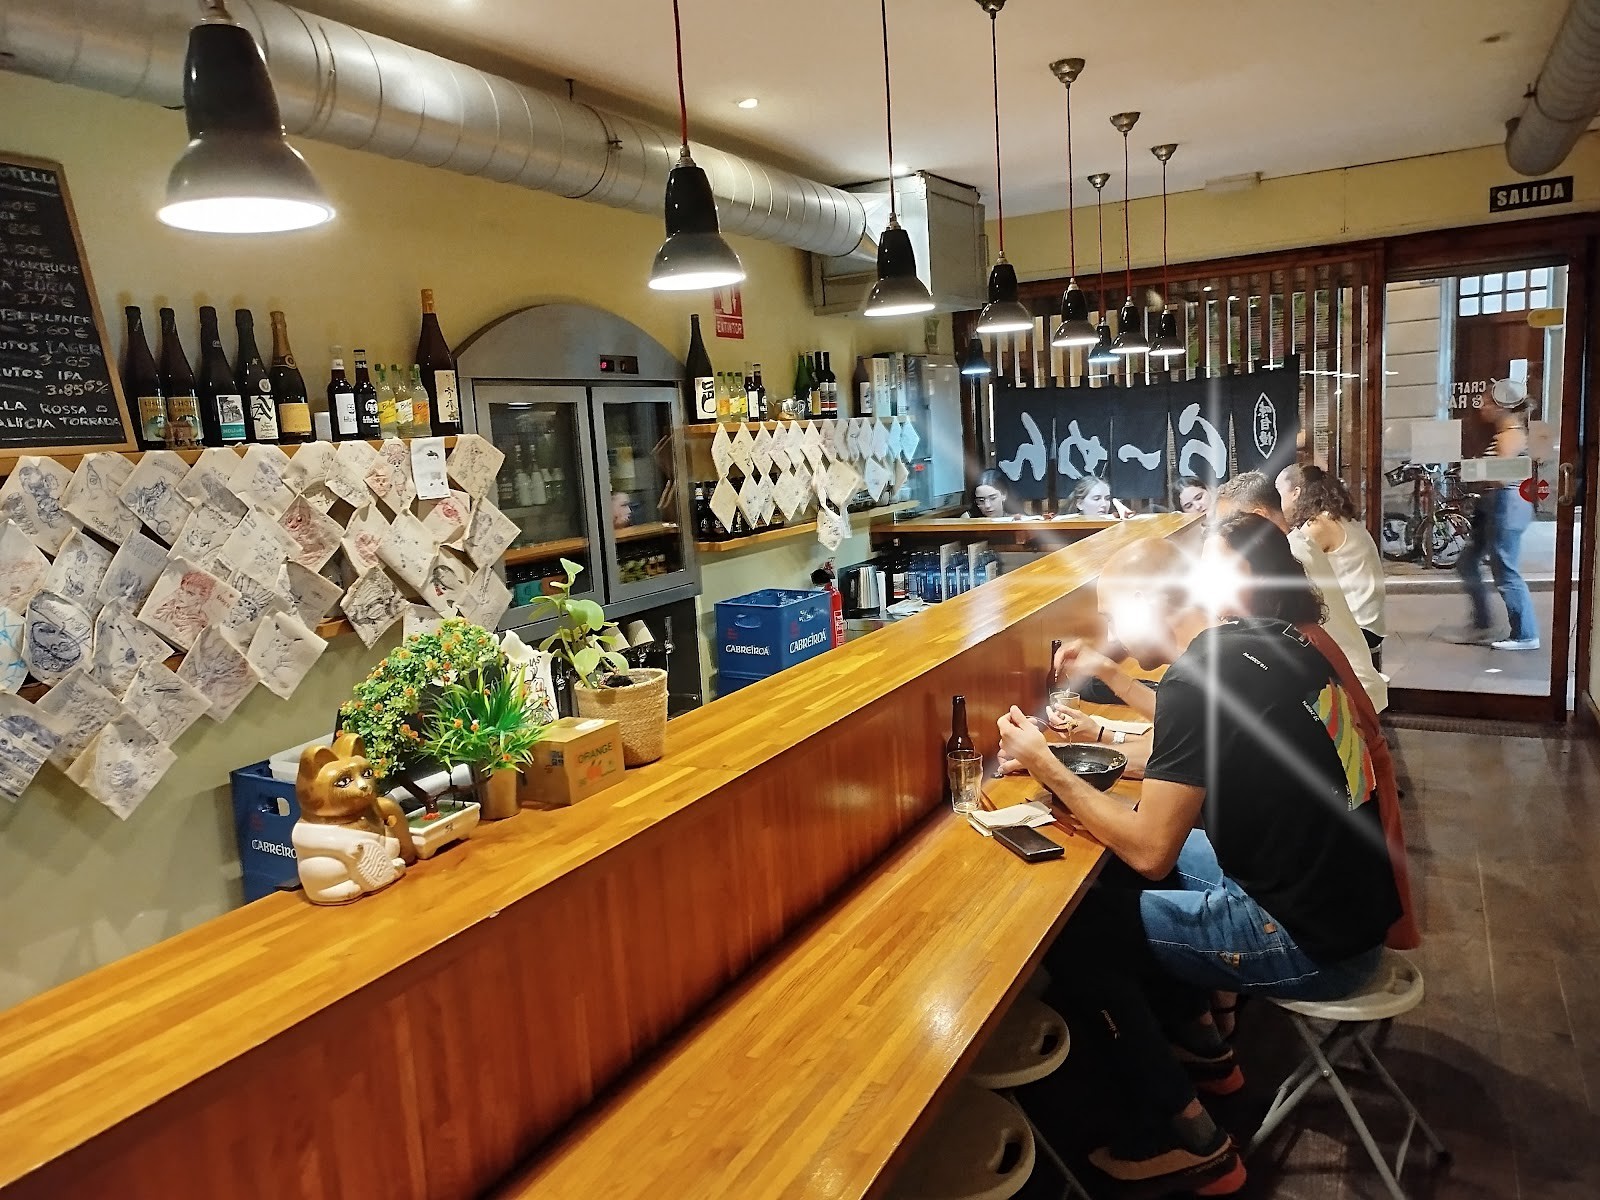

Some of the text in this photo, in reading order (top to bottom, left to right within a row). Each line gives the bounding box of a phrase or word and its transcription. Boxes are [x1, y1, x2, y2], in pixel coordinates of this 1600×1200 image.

[1497, 181, 1565, 207] SALIDA
[717, 320, 743, 334] EXTINTOR
[0, 366, 83, 381] UTOS IPA
[40, 402, 88, 415] ROSSA
[58, 416, 121, 427] TORRADA
[578, 741, 613, 764] ORANGE
